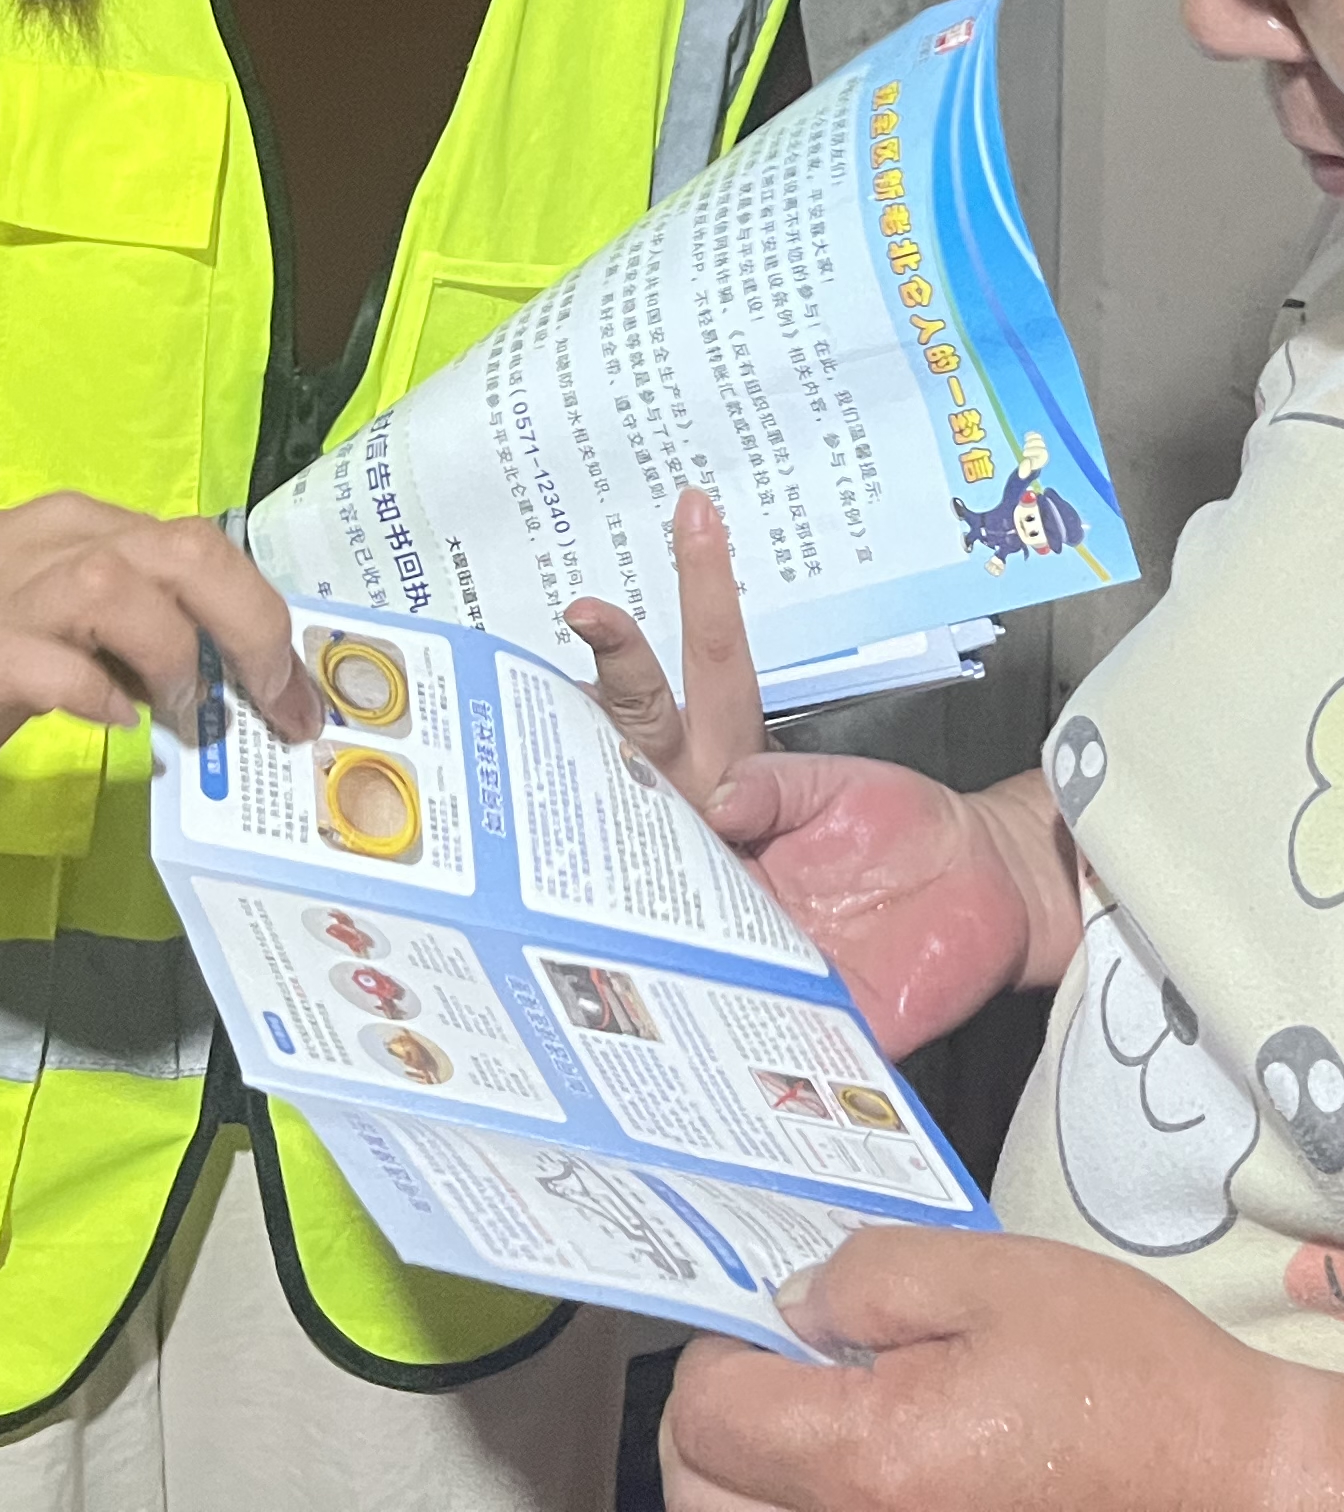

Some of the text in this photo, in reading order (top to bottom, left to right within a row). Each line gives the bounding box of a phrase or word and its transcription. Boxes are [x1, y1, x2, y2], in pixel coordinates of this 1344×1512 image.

[864, 77, 997, 486] 致全区新老北仑人的一封信
